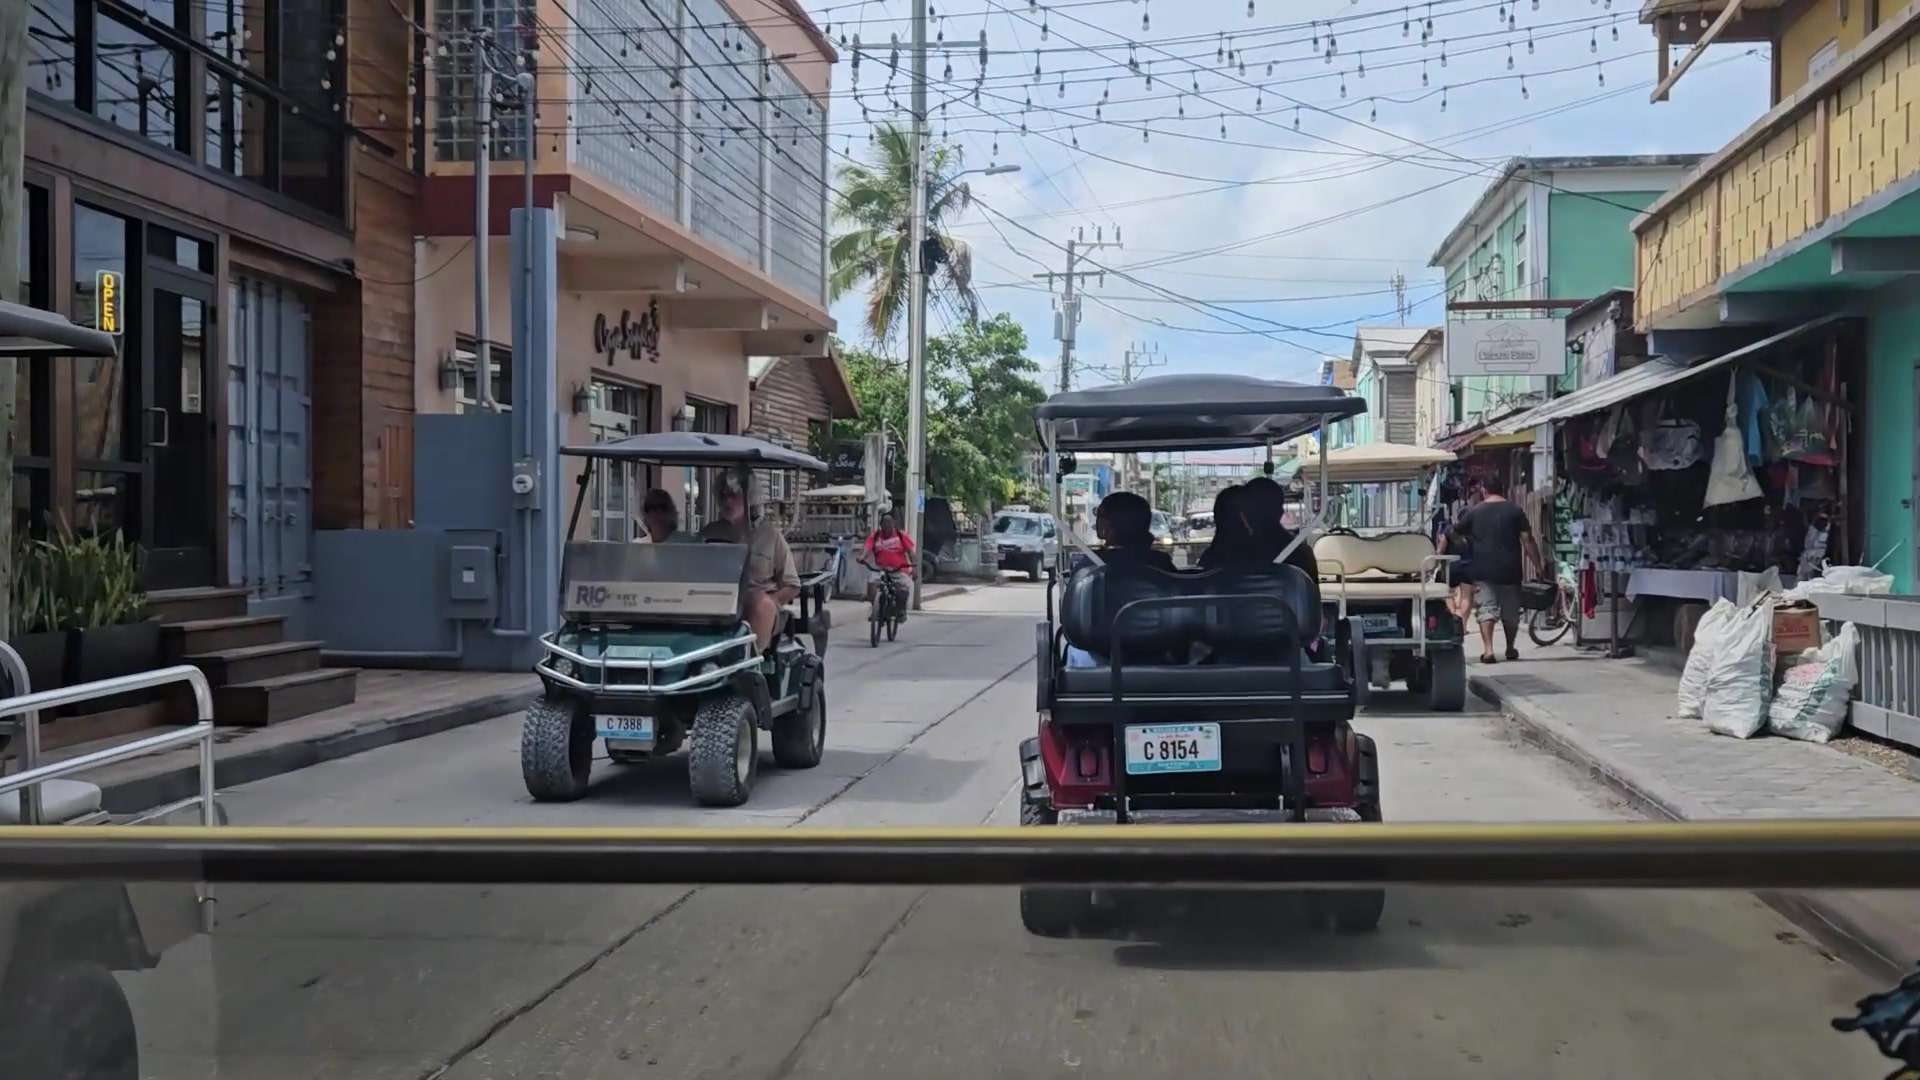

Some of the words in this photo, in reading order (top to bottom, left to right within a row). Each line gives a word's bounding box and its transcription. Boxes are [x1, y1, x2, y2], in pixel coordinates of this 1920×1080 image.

[102, 273, 115, 332] OPEN
[607, 717, 614, 730] C
[1143, 741, 1155, 761] C
[1159, 739, 1200, 761] 8154
